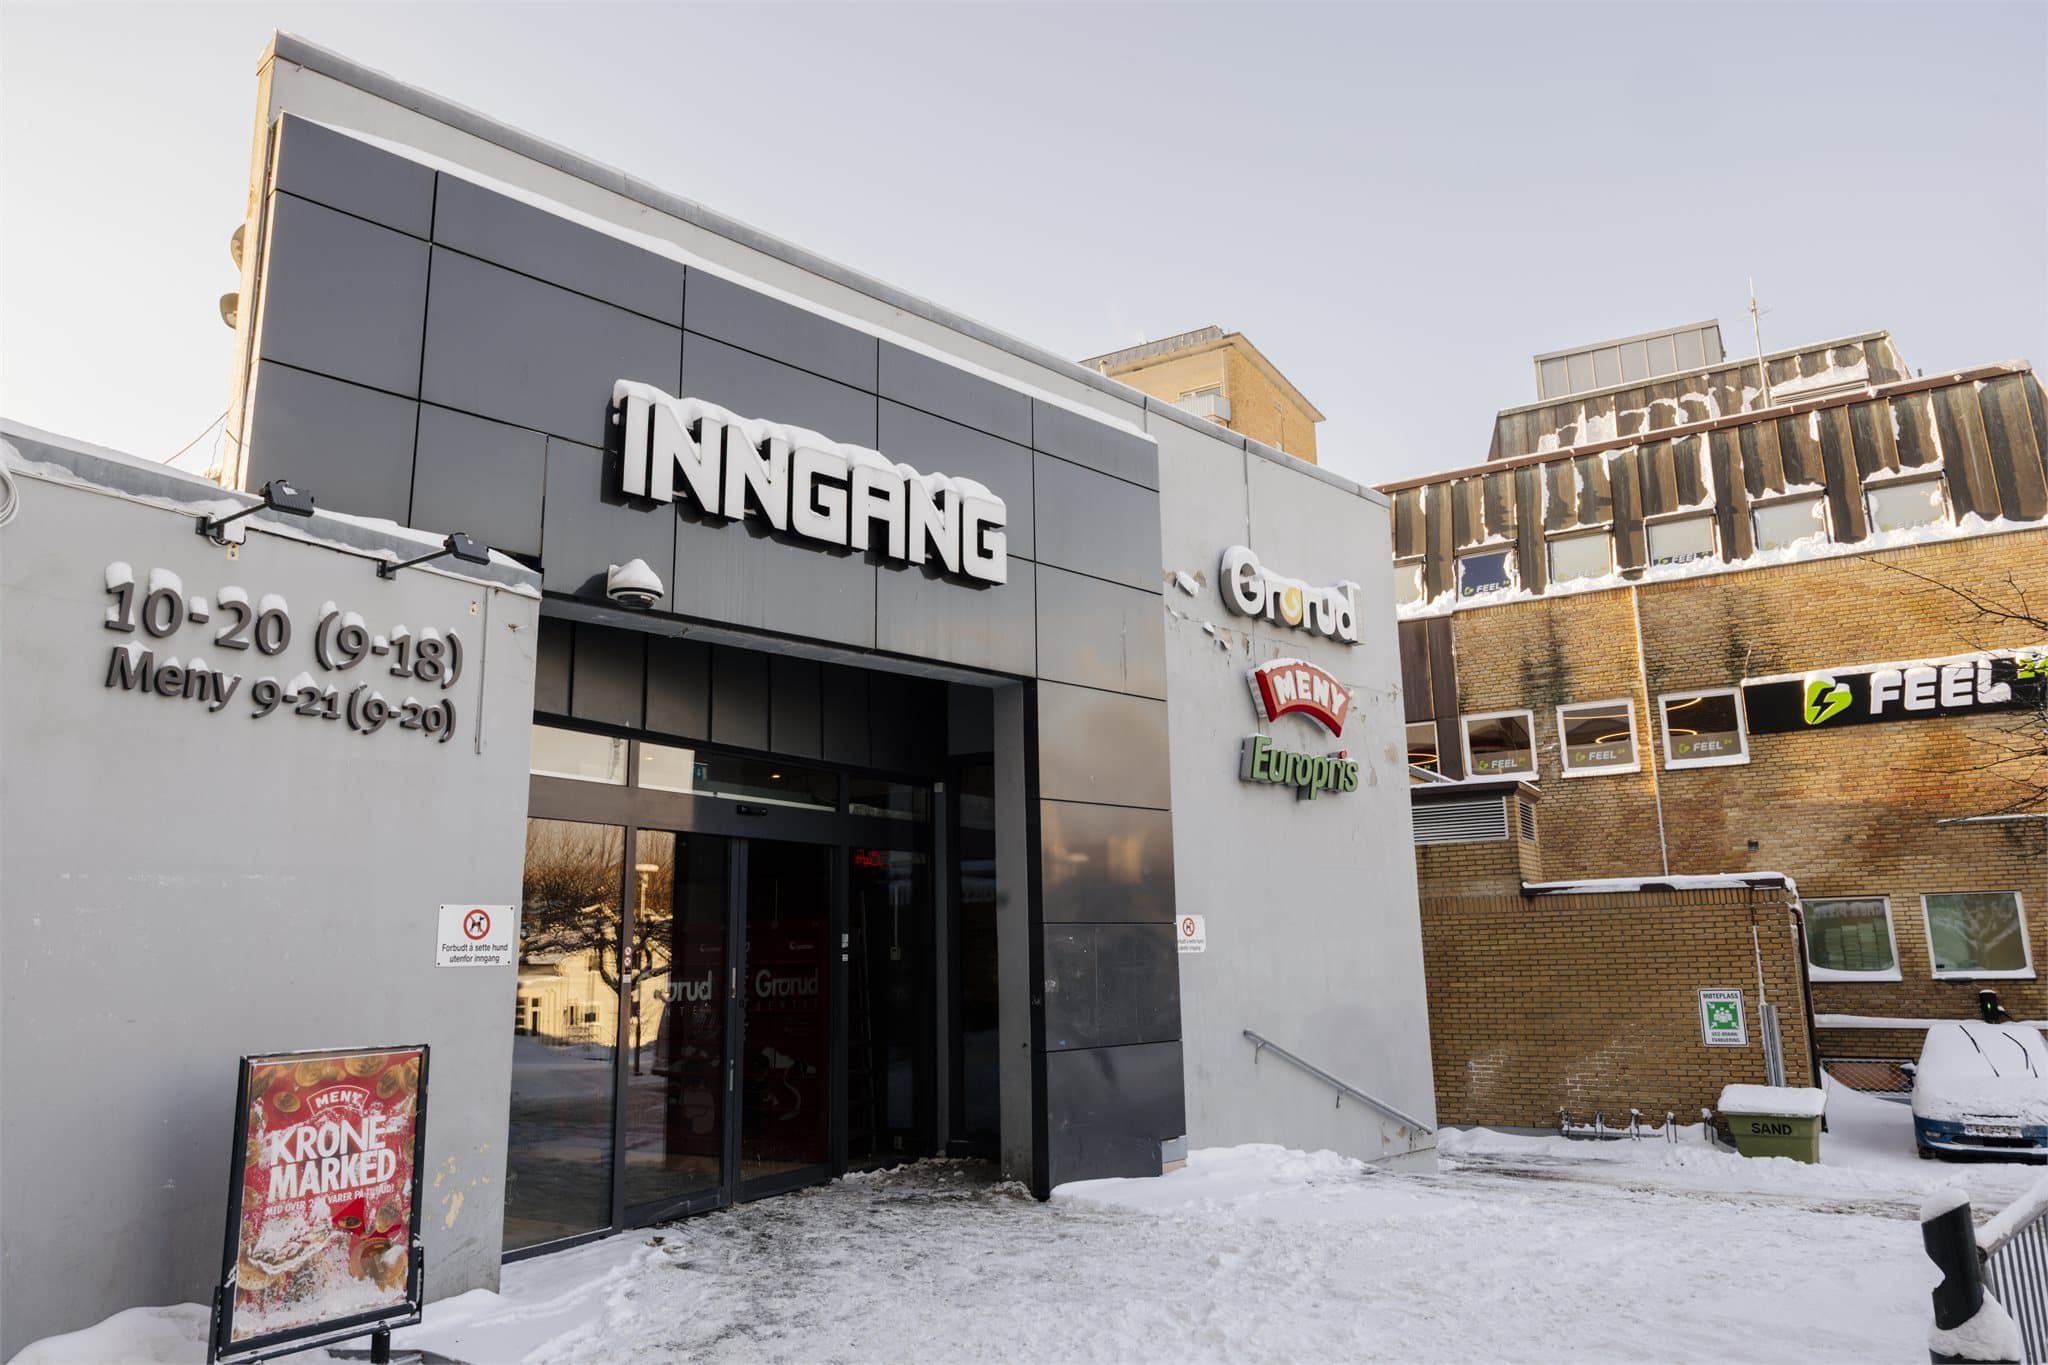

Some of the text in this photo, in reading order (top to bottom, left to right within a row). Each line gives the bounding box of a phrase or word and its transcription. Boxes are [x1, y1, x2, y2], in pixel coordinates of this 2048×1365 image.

[620, 387, 1007, 585] INNGANG
[1222, 549, 1358, 643] Grorud
[1476, 582, 1501, 593] FEEL
[104, 578, 463, 689] 10-20 (9-18)
[105, 644, 242, 712] Meny
[1273, 669, 1346, 716] MENY
[1870, 659, 2012, 714] FEEL
[1491, 759, 1517, 769] FEEL
[1588, 751, 1616, 761] FEEL
[1692, 741, 1723, 752] FEEL
[1252, 736, 1358, 800] Europris
[442, 943, 508, 952] Forbudt å sette hund
[449, 955, 500, 964] utenfor inngang
[755, 967, 819, 998] Grorud
[270, 1115, 387, 1166] KRONE
[1751, 1122, 1793, 1136] SAND
[267, 1148, 396, 1203] MARKED
[327, 1191, 352, 1204] VARER
